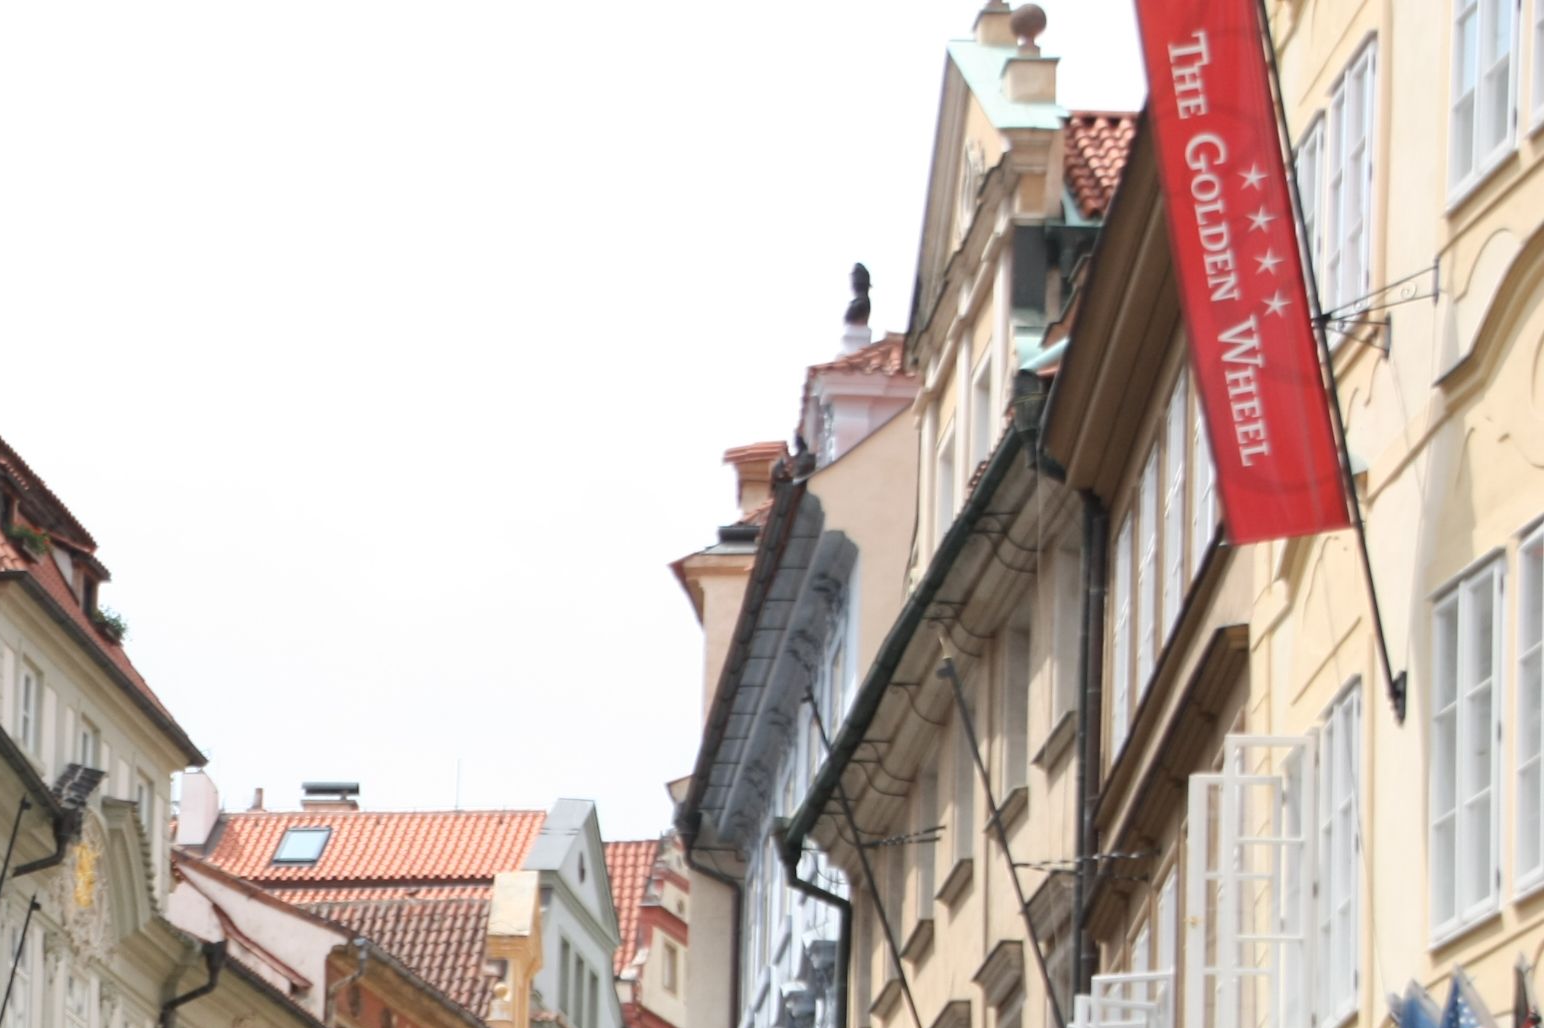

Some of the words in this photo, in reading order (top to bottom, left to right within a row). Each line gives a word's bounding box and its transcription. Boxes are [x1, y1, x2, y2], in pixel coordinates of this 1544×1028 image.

[1167, 29, 1211, 120] THE
[1185, 132, 1241, 304] GOLDEN
[1217, 314, 1270, 468] WHEEL
